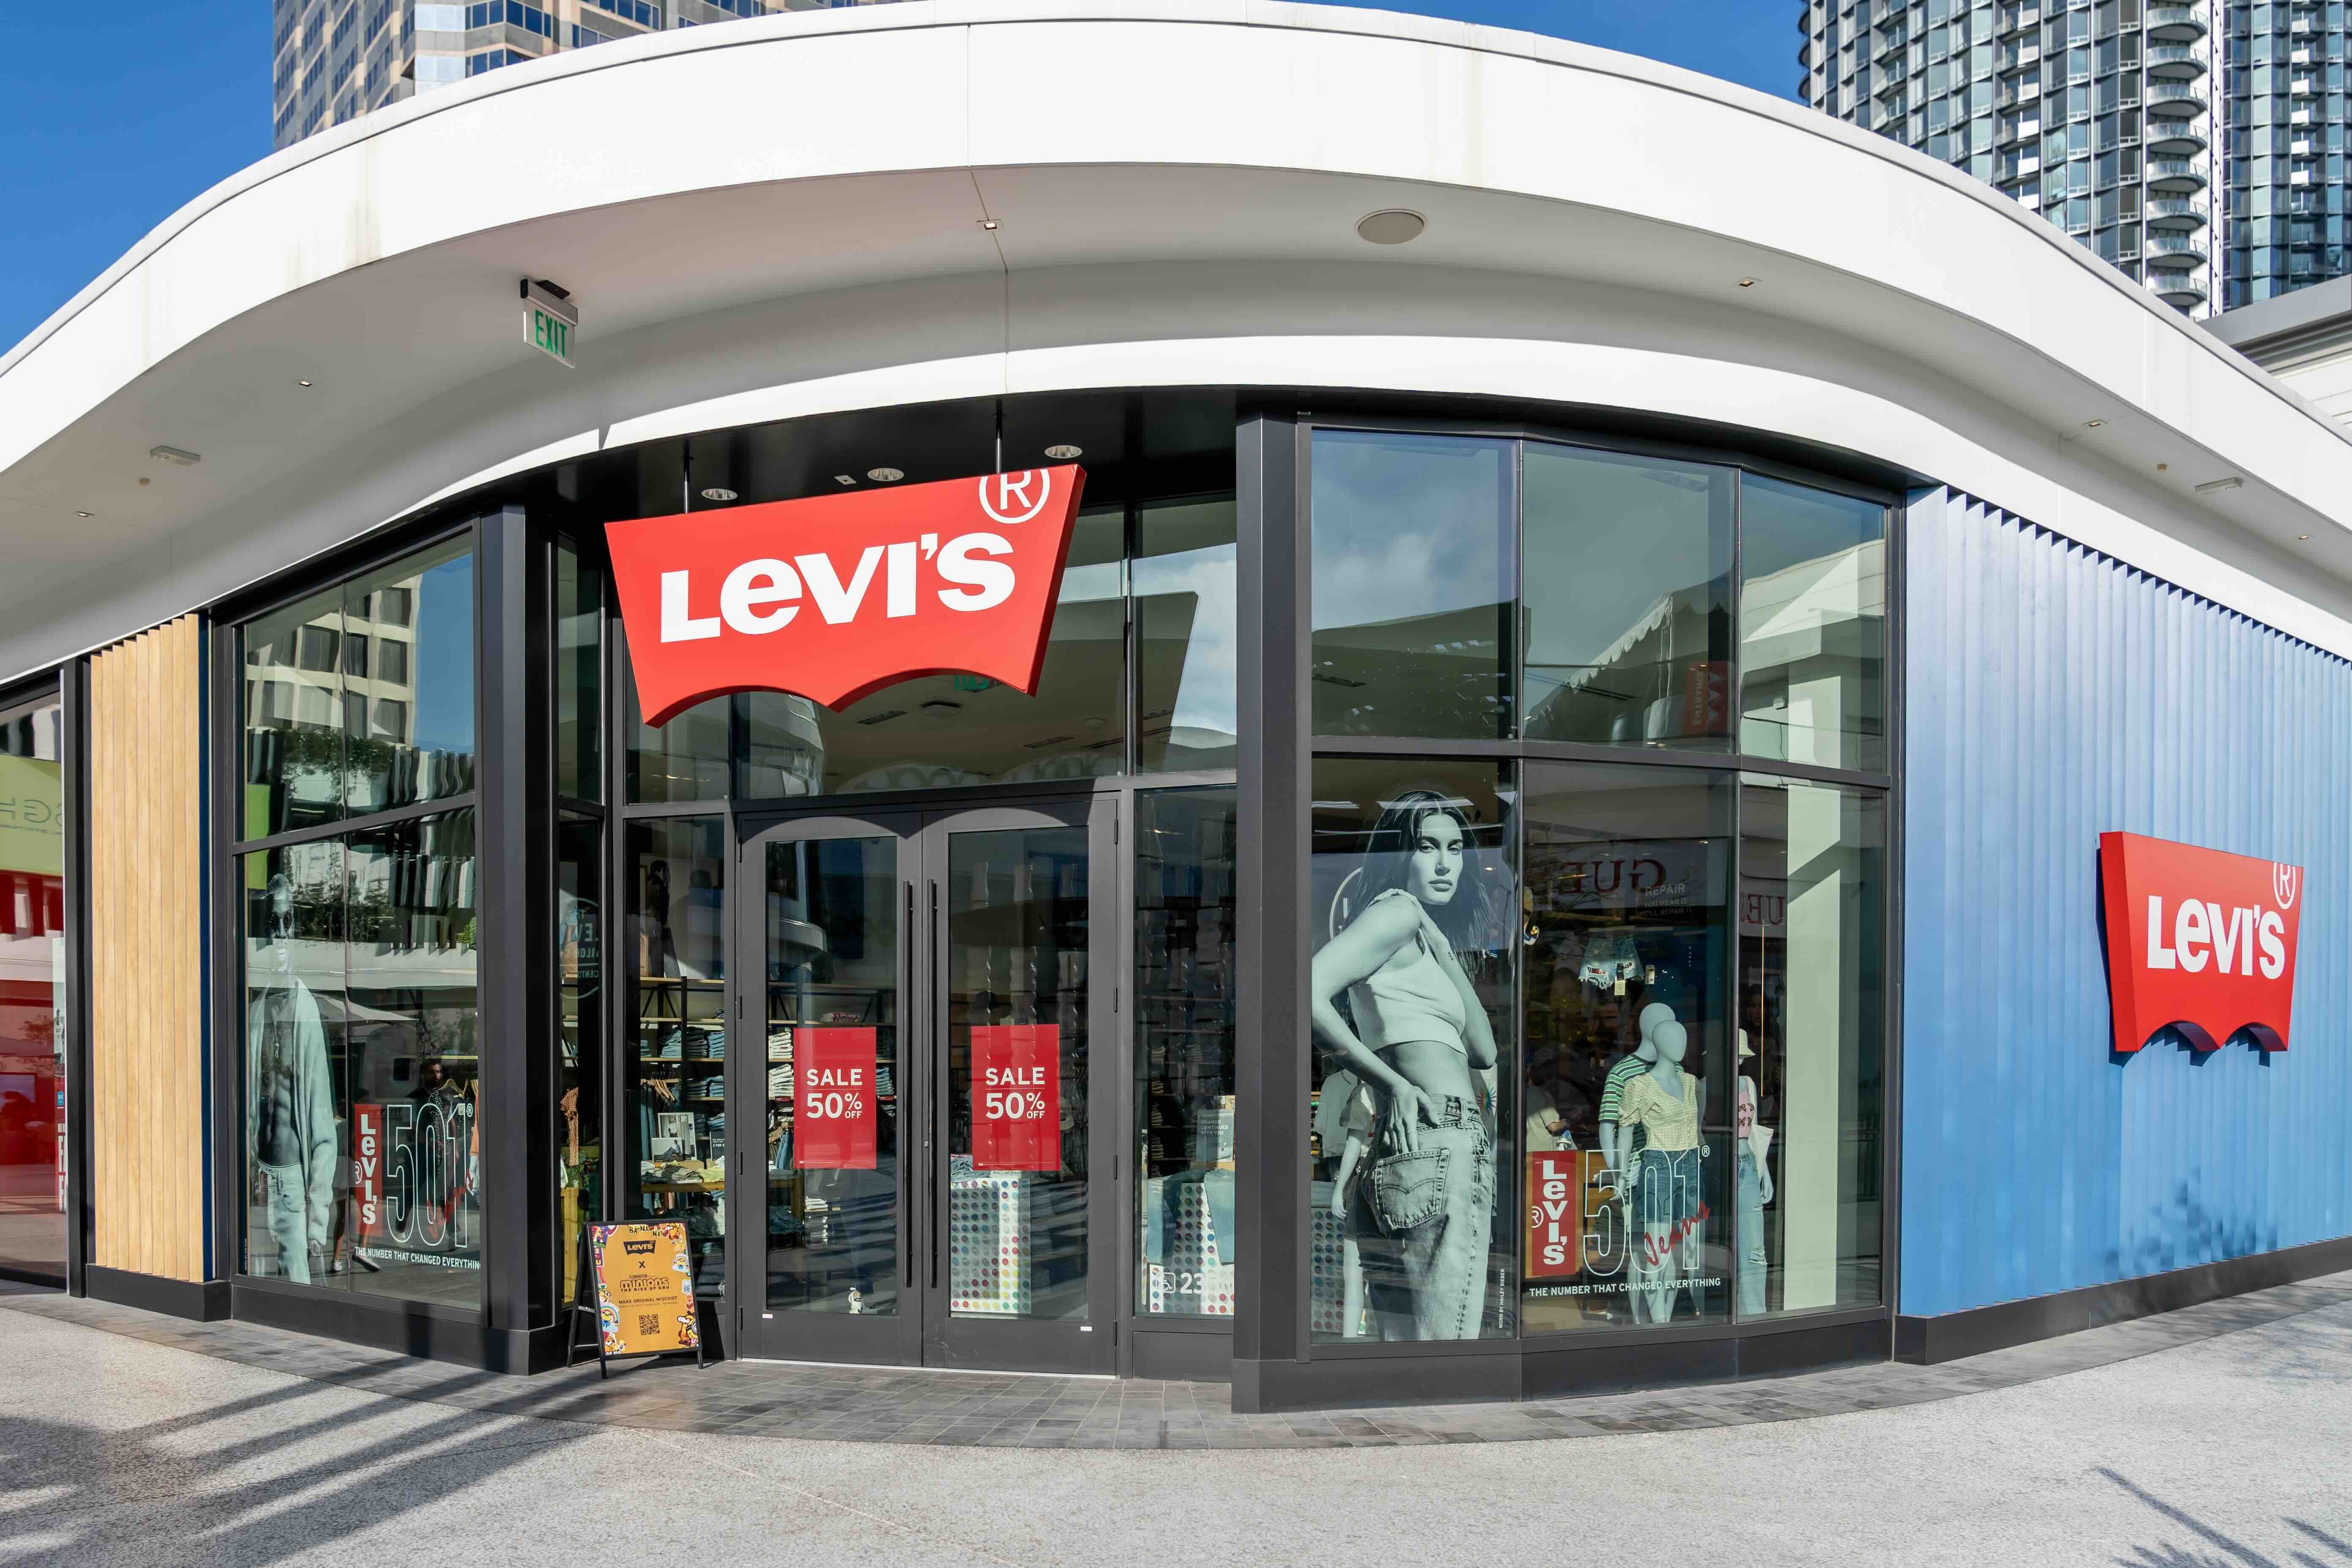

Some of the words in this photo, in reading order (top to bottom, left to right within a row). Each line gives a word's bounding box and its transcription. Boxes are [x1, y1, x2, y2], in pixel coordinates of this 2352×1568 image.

[535, 309, 567, 359] EXIT
[1644, 883, 1686, 896] REPAIR
[806, 1068, 863, 1086] SALE
[985, 1067, 1046, 1086] SALE
[806, 1092, 863, 1119] 50%
[845, 1110, 862, 1119] OFF
[985, 1091, 1046, 1119] 50%
[1026, 1110, 1046, 1119] OFF
[354, 1247, 366, 1256] THE
[368, 1249, 392, 1259] NUMBER
[393, 1252, 410, 1261] THAT
[411, 1253, 441, 1265] CHANGED
[1529, 1288, 1548, 1297] THE
[1551, 1285, 1591, 1295] NUMBER
[1593, 1283, 1617, 1293] THAT
[1619, 1281, 1663, 1292] CHANGED
[1665, 1277, 1721, 1289] EVERYTHING
